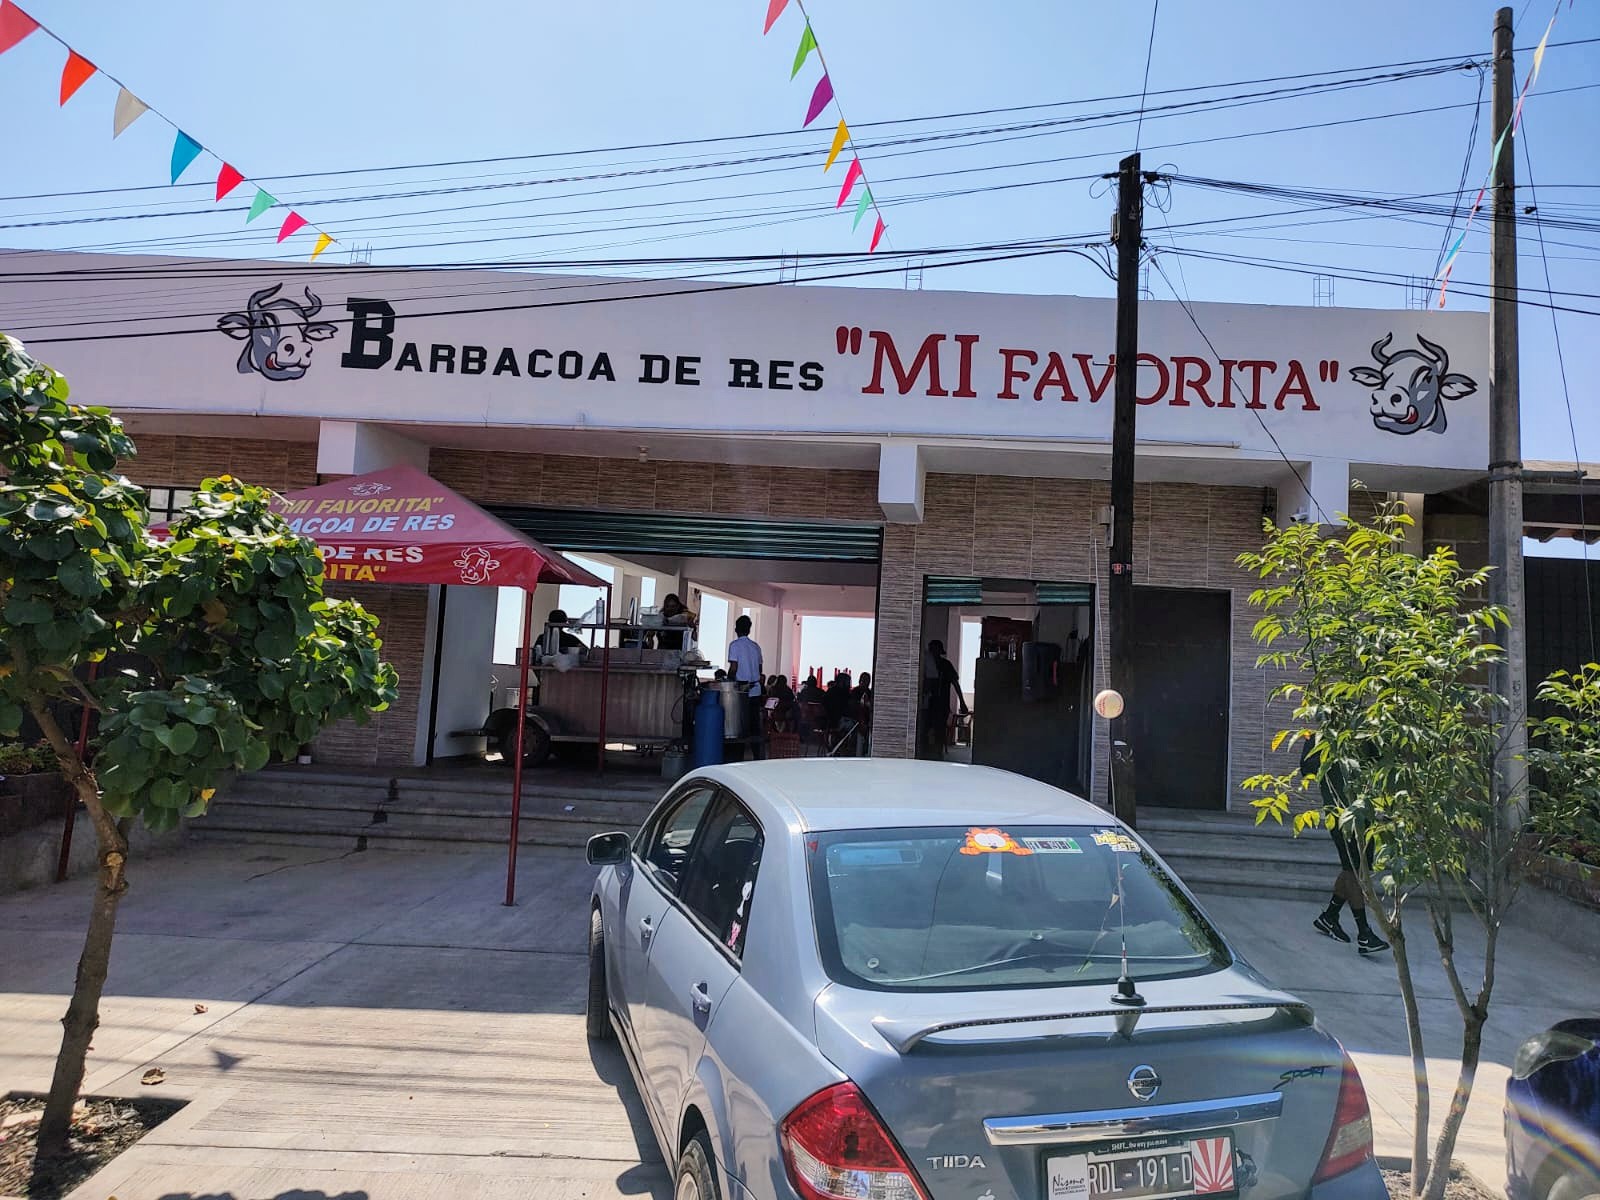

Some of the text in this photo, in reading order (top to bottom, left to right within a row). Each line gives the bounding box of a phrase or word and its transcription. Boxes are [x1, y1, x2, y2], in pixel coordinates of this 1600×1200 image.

[341, 297, 616, 383] BARBACOA
[638, 354, 701, 386] DE
[727, 357, 825, 392] RES
[836, 326, 980, 398] "MI
[362, 516, 399, 534] DE
[402, 513, 456, 532] RES
[318, 545, 355, 560] DE
[926, 1155, 987, 1170] TIIDA
